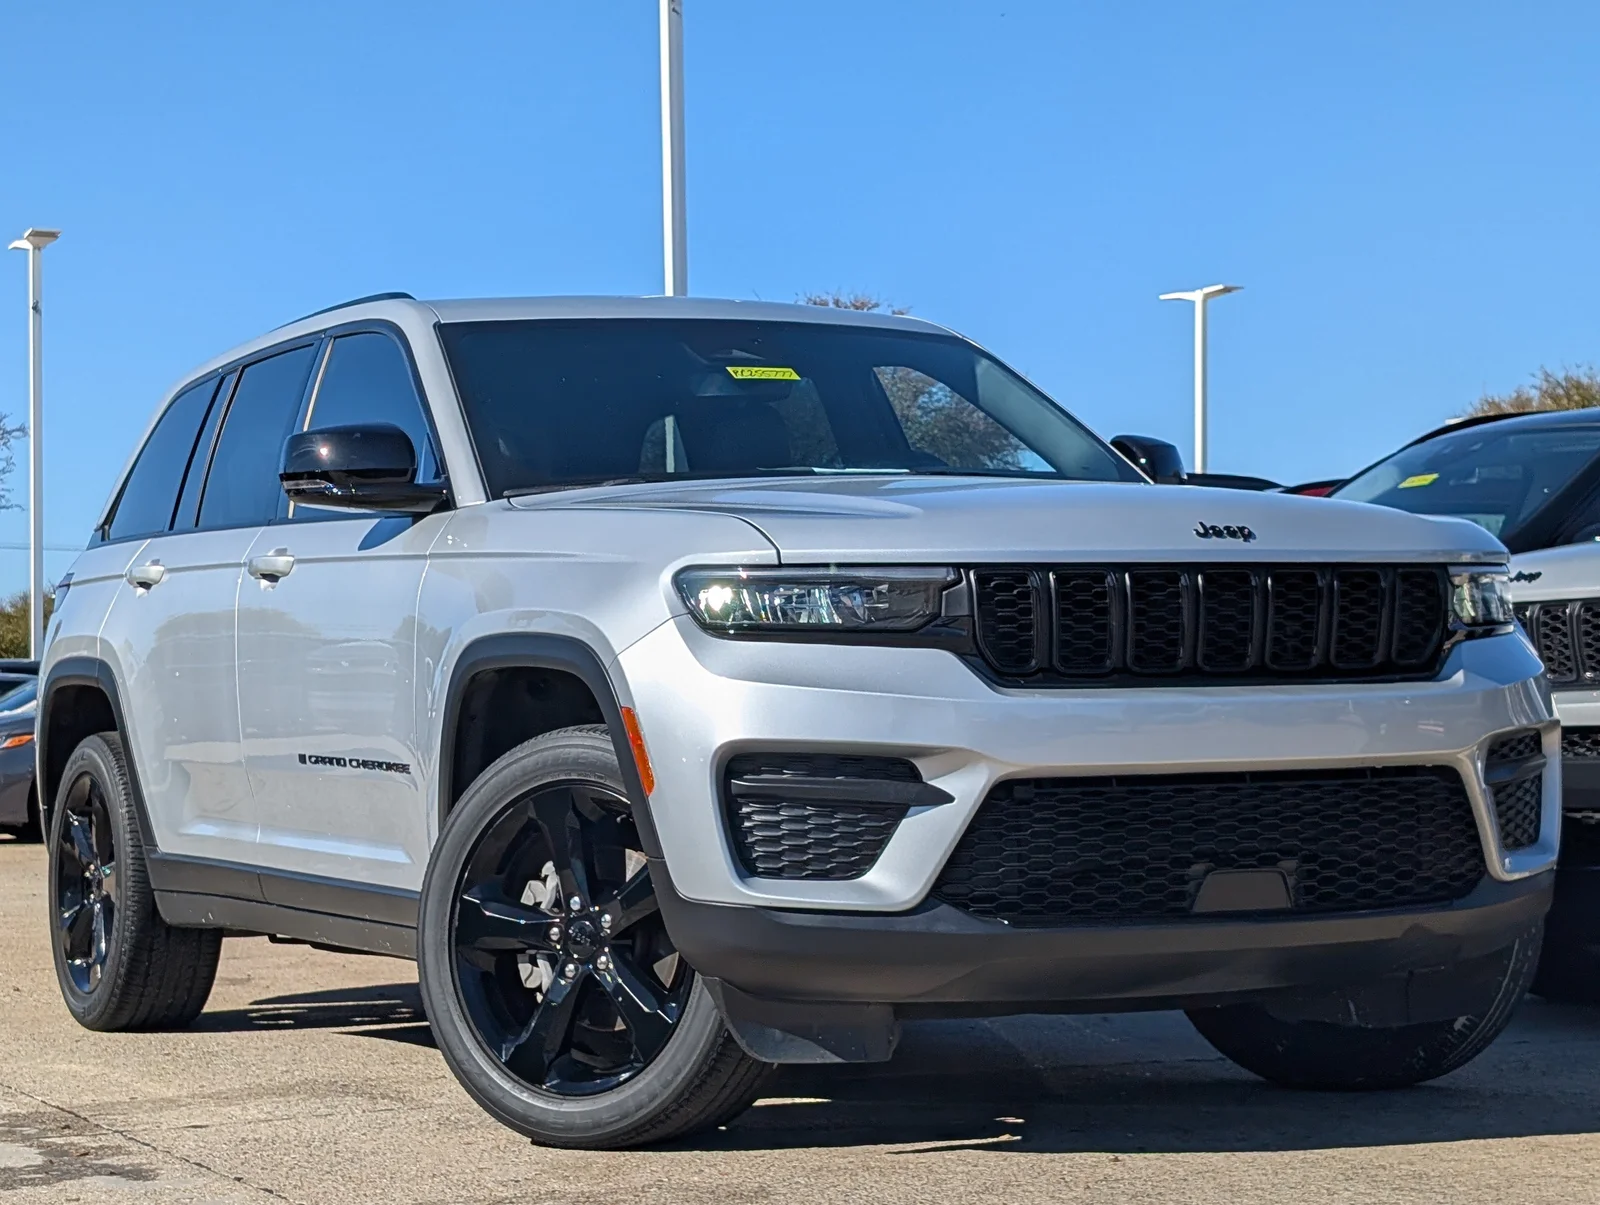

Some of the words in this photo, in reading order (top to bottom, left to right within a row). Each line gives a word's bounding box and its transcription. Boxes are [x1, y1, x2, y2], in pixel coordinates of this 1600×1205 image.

[1193, 521, 1257, 543] Jeep
[308, 754, 347, 768] GRAND
[348, 758, 412, 775] CHEROKEE
